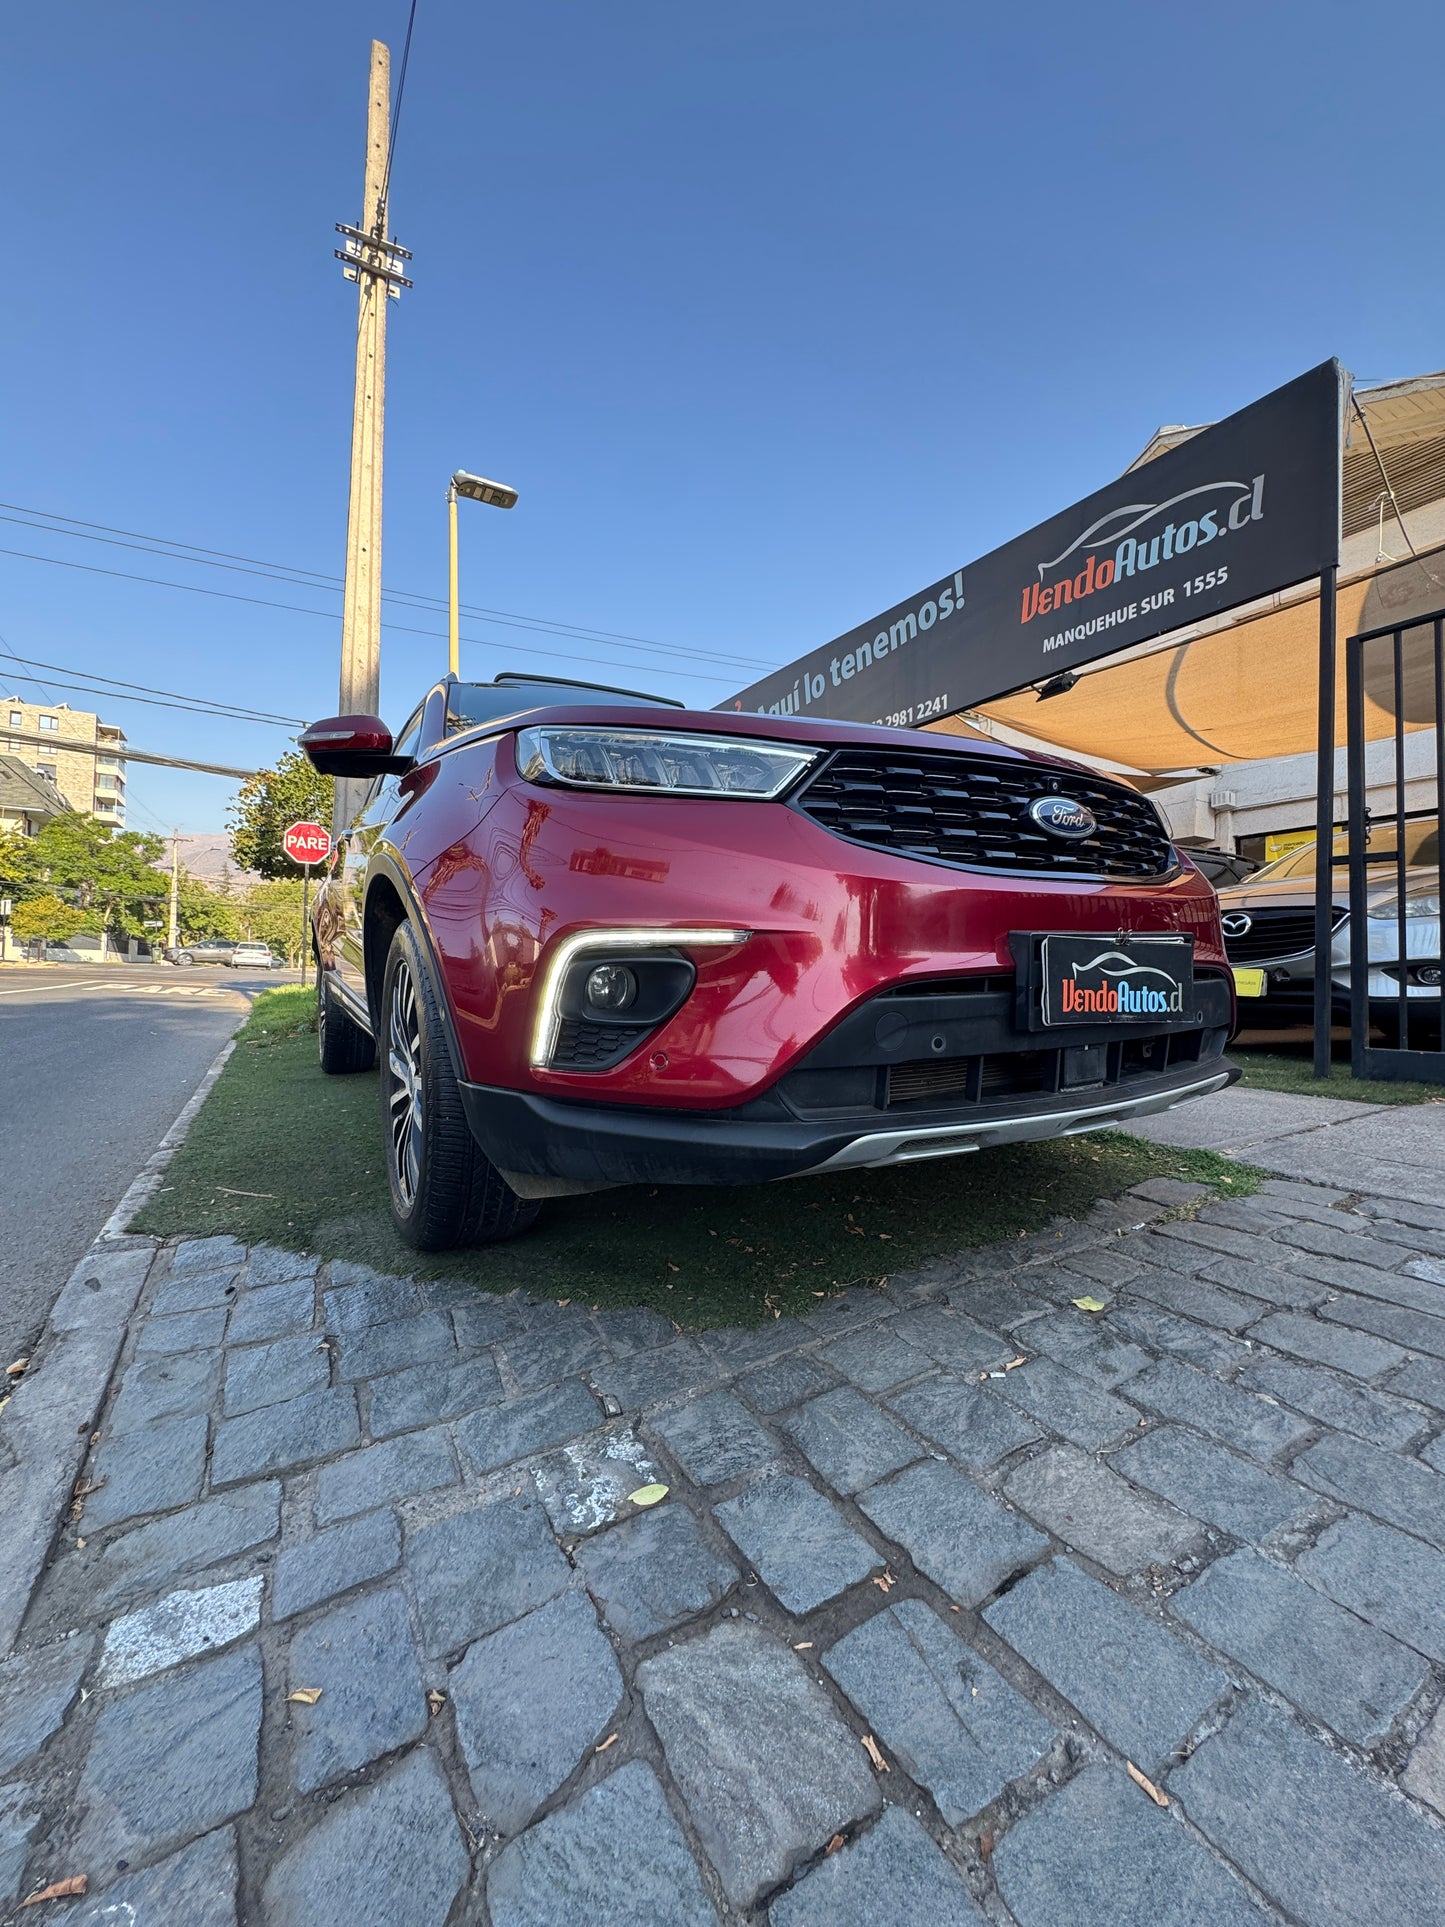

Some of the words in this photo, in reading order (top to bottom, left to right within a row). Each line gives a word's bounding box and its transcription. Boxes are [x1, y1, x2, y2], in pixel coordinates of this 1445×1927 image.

[1020, 474, 1265, 624] VendoAutos.cl
[1042, 602, 1138, 653] MANQUEHUE
[1140, 588, 1176, 616] SUR
[1183, 566, 1229, 598] 1555
[803, 672, 826, 705] lo
[829, 570, 966, 687] tenemos!
[916, 693, 949, 720] 2241
[1051, 804, 1086, 828] Ford
[287, 835, 328, 851] PARE
[82, 983, 232, 997] PARE
[1062, 979, 1184, 1013] VendoAutos.cl
